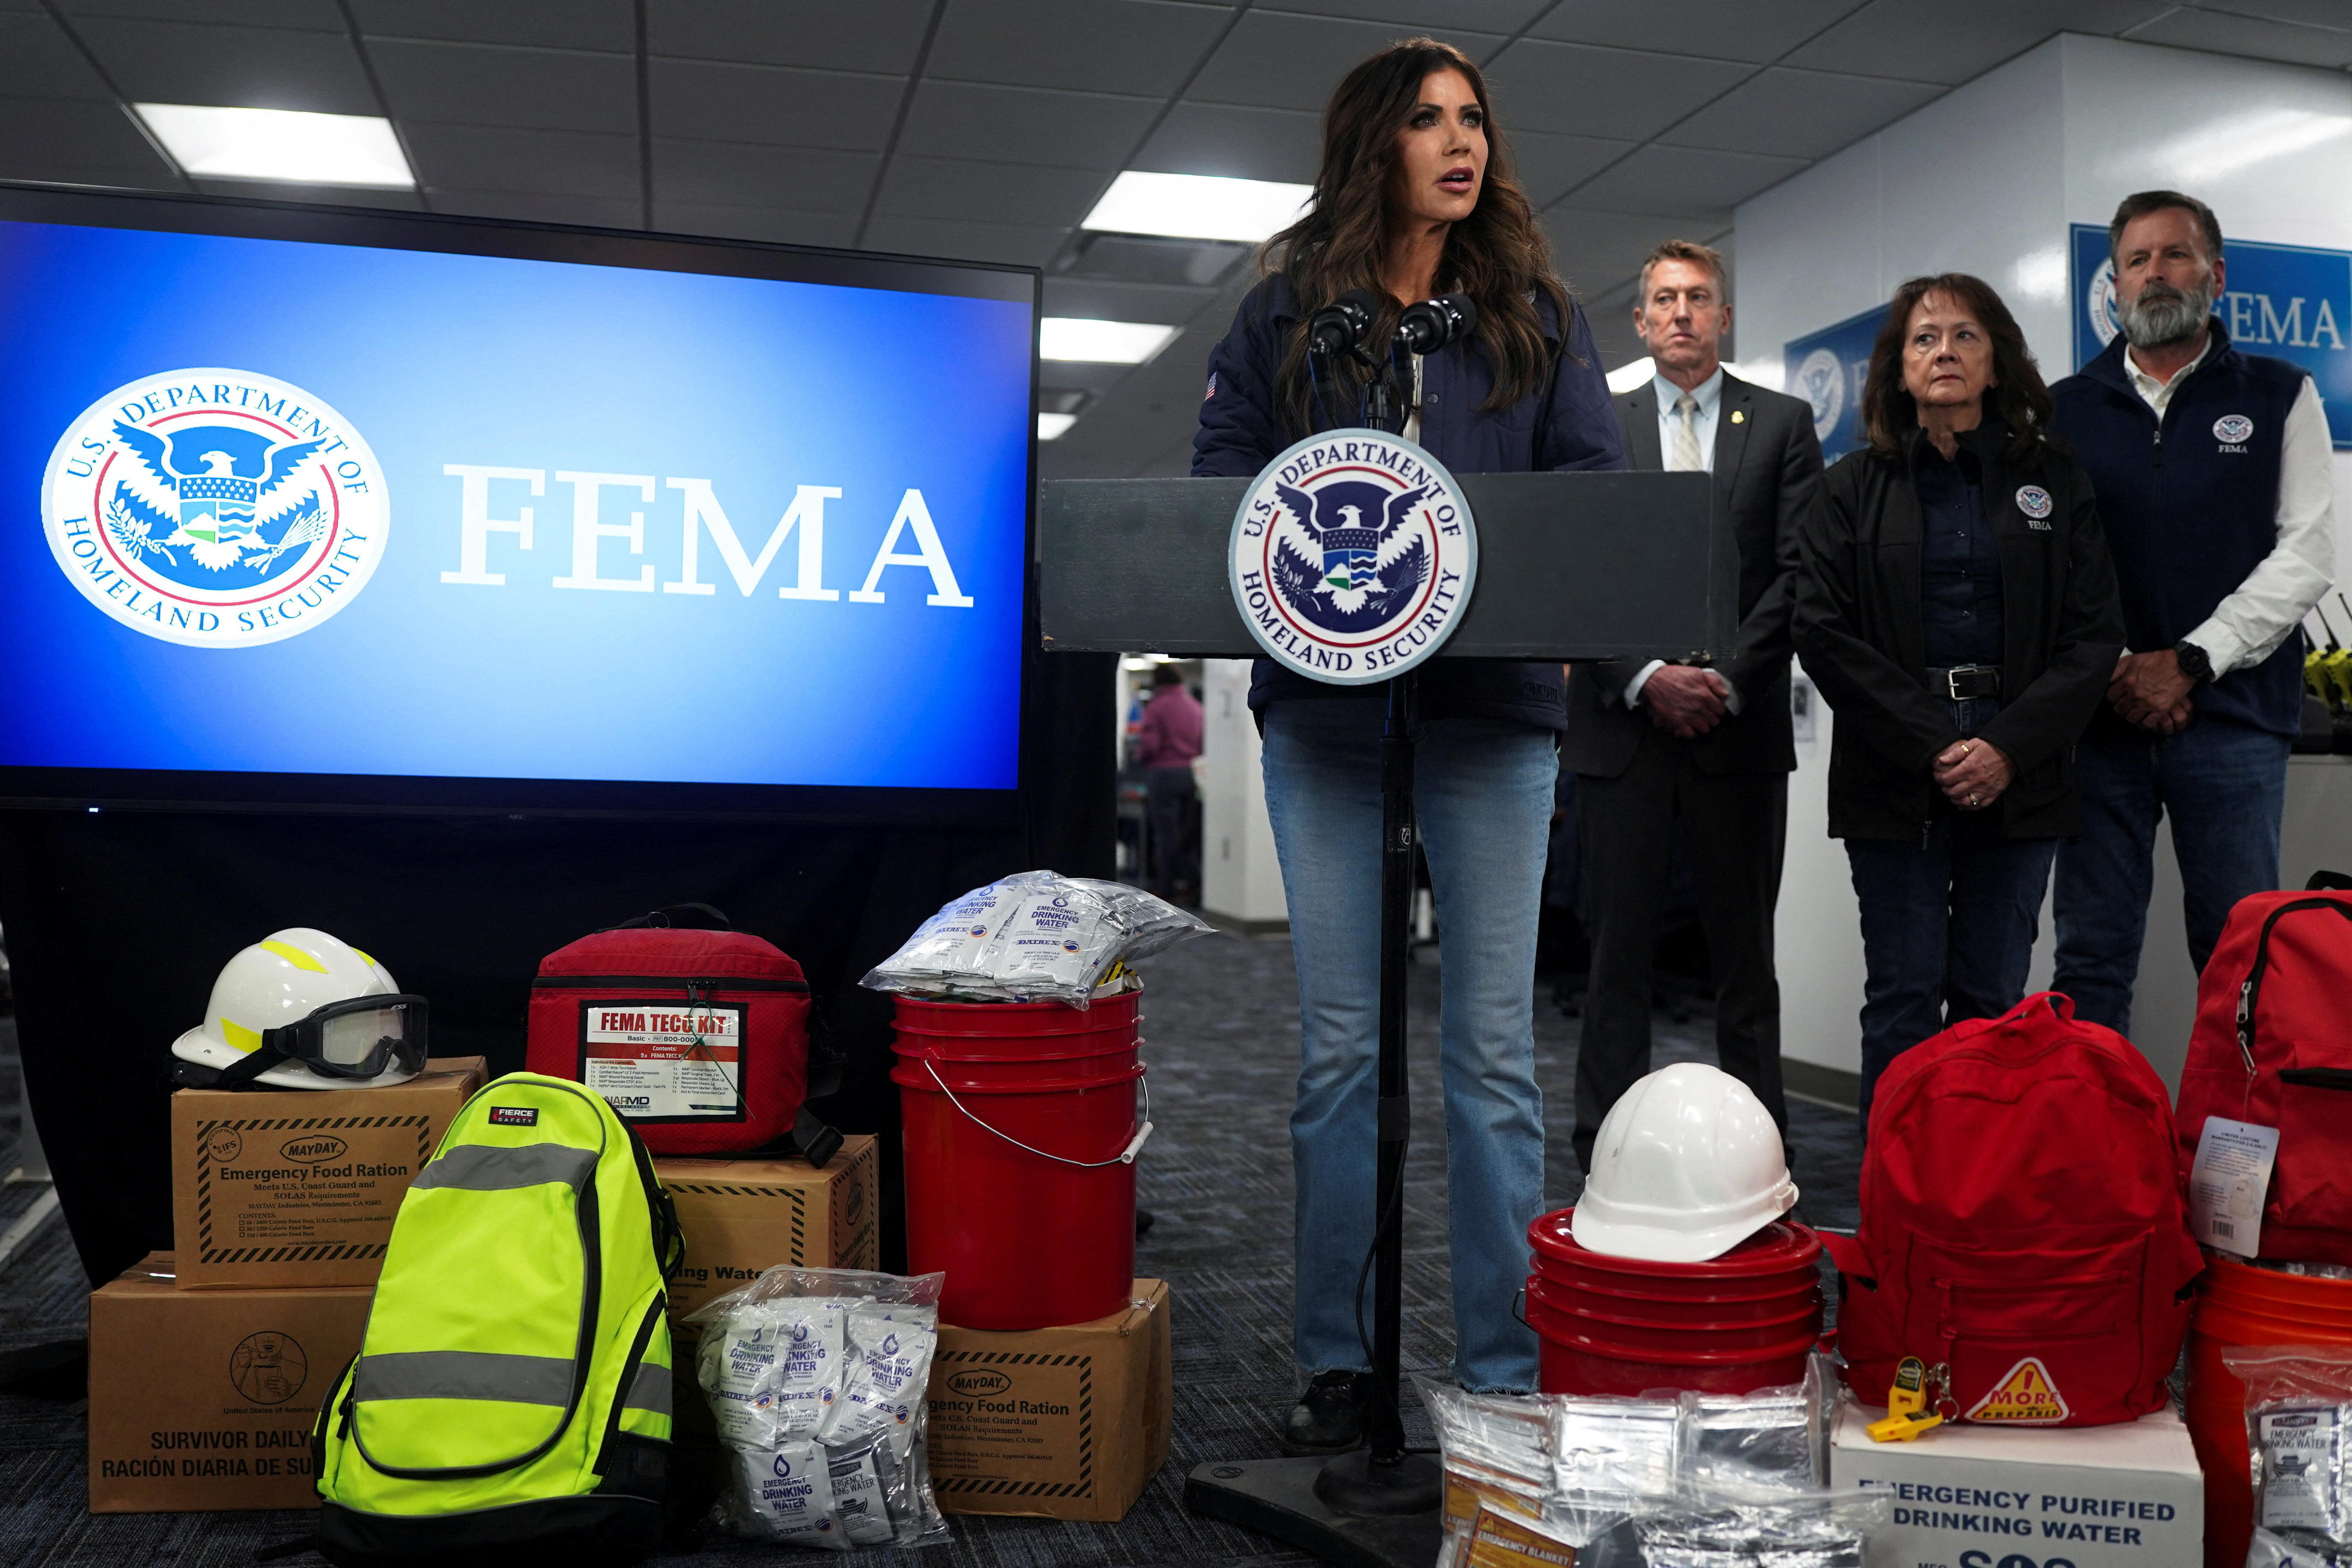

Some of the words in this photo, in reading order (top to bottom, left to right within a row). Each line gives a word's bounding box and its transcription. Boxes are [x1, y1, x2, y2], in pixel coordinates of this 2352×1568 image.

[2217, 292, 2345, 350] EMA
[66, 437, 111, 478] U.S.
[119, 384, 349, 455] DEPARTMENT
[338, 460, 369, 494] OF
[2218, 445, 2248, 454] FEMA
[1244, 499, 1274, 537] U.S.
[1279, 442, 1446, 502] DEPARTMENT
[1437, 504, 1461, 537] OF
[2027, 520, 2052, 531] FEMA
[441, 464, 974, 608] FEMA
[63, 515, 219, 631] HOMELAND
[239, 527, 367, 631] SECURITY
[1243, 570, 1352, 671] HOMELAND
[1365, 567, 1460, 670] SECURITY
[1031, 911, 1079, 923] DRINKING
[1037, 906, 1078, 915] EMERGENCY
[1036, 919, 1069, 928] WATER
[601, 1013, 645, 1031] FEMA
[650, 1014, 693, 1033] TECC
[698, 1016, 726, 1033] KIT
[222, 1141, 237, 1151] IFS
[289, 1142, 339, 1156] MAYDAY
[220, 1168, 308, 1182] Emergency
[313, 1164, 352, 1178] Food
[356, 1163, 407, 1177] Ration
[309, 1192, 360, 1201] Requirements
[731, 1360, 763, 1373] WATER
[872, 1368, 902, 1386] WATER
[955, 1377, 1003, 1389] MAYDAY
[1988, 1390, 2060, 1405] MORE
[978, 1400, 1015, 1413] Food
[1020, 1401, 1069, 1415] Ration
[974, 1425, 1022, 1434] Requirements
[2271, 1429, 2316, 1439] EMERGENCY
[150, 1430, 248, 1449] SURVIVOR
[256, 1430, 309, 1448] DAILY
[2297, 1439, 2326, 1449] WATER
[102, 1456, 176, 1478] RACIÓN
[183, 1458, 249, 1477] DIARIA
[256, 1458, 281, 1475] DE
[763, 1475, 806, 1488] EMERGENCY
[832, 1473, 863, 1489] ERGENCY
[849, 1478, 875, 1493] WATER
[762, 1484, 813, 1500] DRINKING
[772, 1498, 807, 1510] WATER
[1859, 1480, 2030, 1511] ERGENCY
[2041, 1495, 2175, 1522] PURIFIED
[1893, 1508, 2032, 1537] DRINKING
[2041, 1522, 2142, 1546] WATER
[1478, 1531, 1528, 1555] EMERGENCY
[1528, 1547, 1570, 1565] BLANKET
